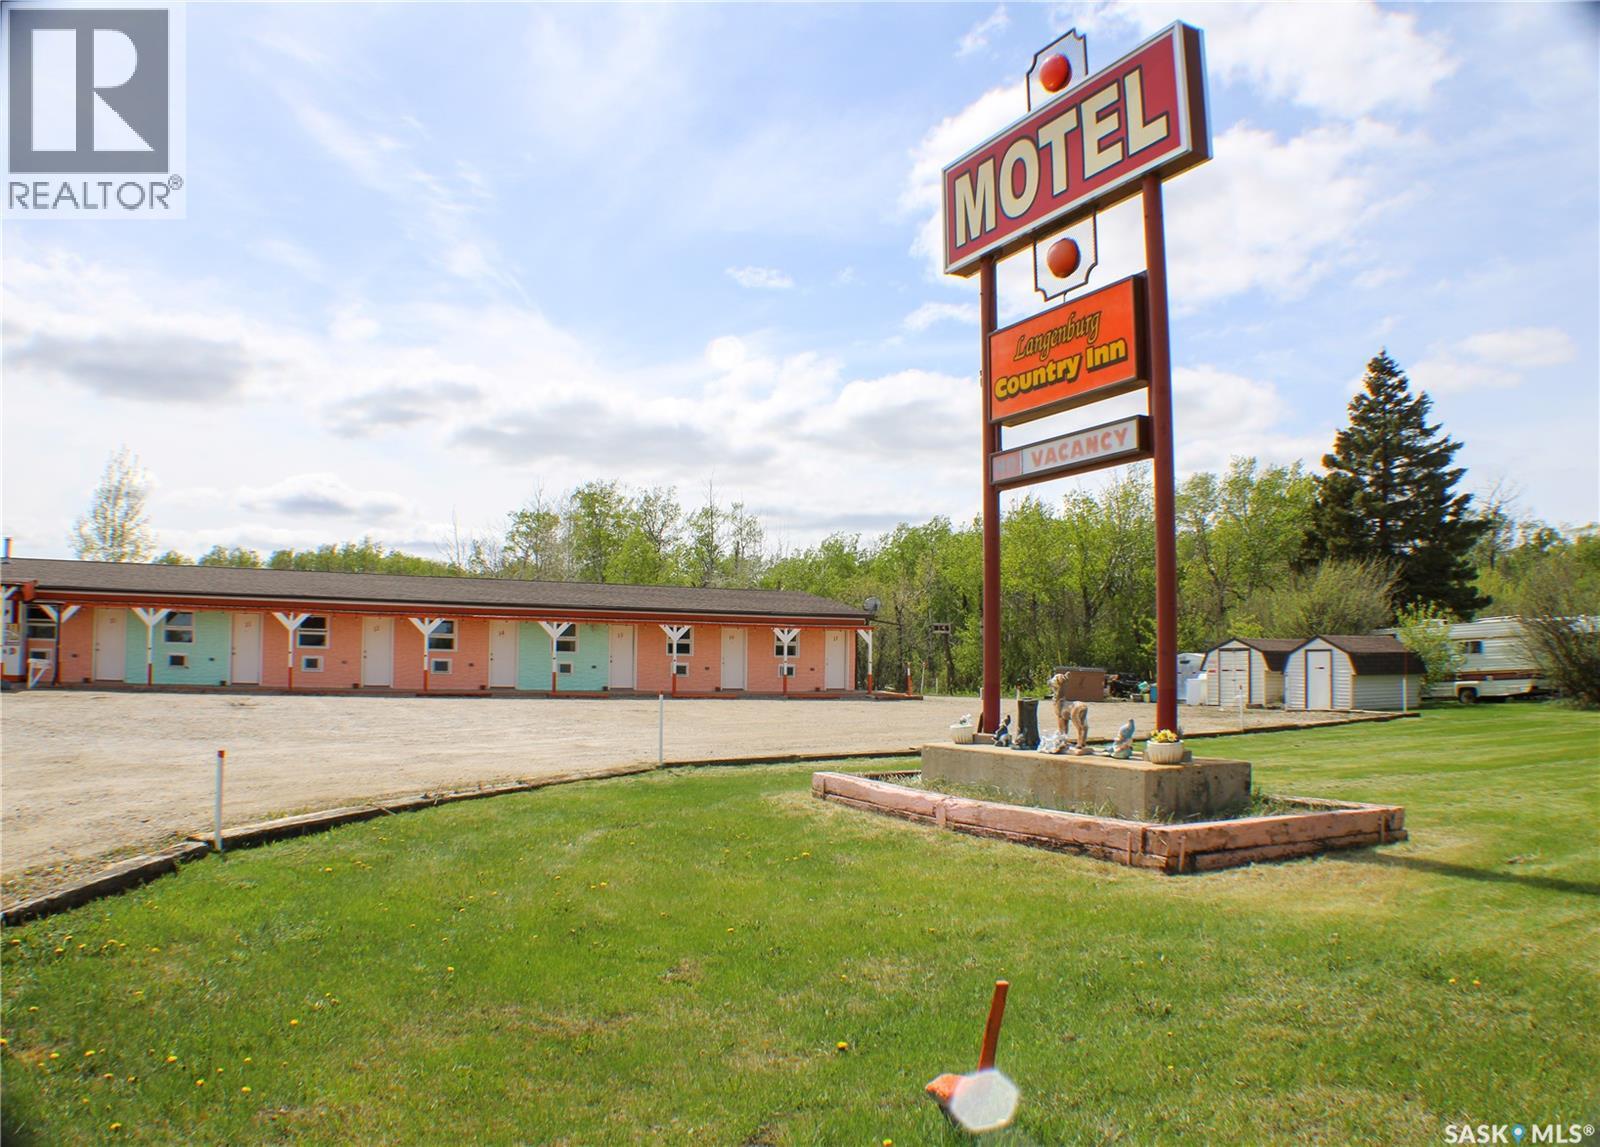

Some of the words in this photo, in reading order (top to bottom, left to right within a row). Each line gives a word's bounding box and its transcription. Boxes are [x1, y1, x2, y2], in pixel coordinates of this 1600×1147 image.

[953, 64, 1170, 248] MOTEL
[1013, 311, 1102, 361] Langenburg
[1086, 338, 1128, 372] Inn
[1031, 428, 1128, 467] VACANCY
